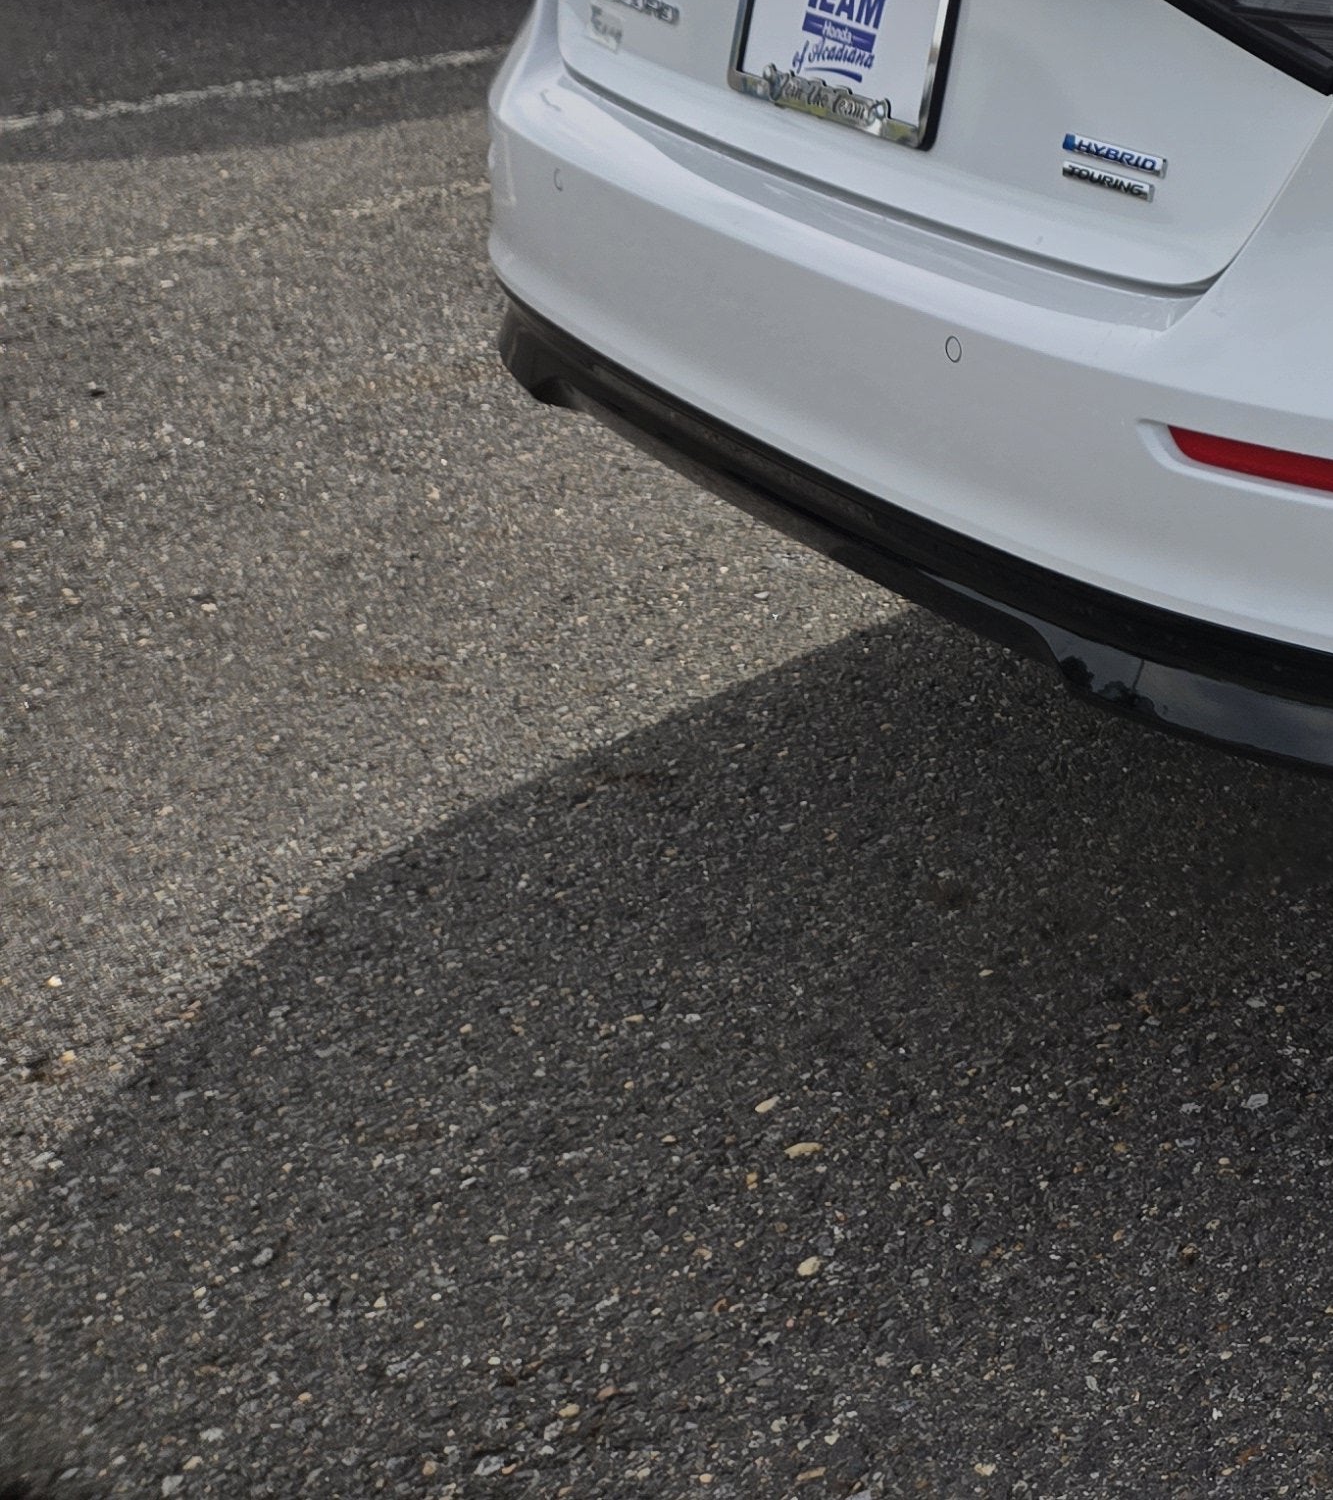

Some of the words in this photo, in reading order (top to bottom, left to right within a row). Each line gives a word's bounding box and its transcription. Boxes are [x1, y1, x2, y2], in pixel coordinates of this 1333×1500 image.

[792, 40, 810, 74] of
[1075, 139, 1157, 171] HYBRID
[1067, 164, 1145, 197] TOURING
